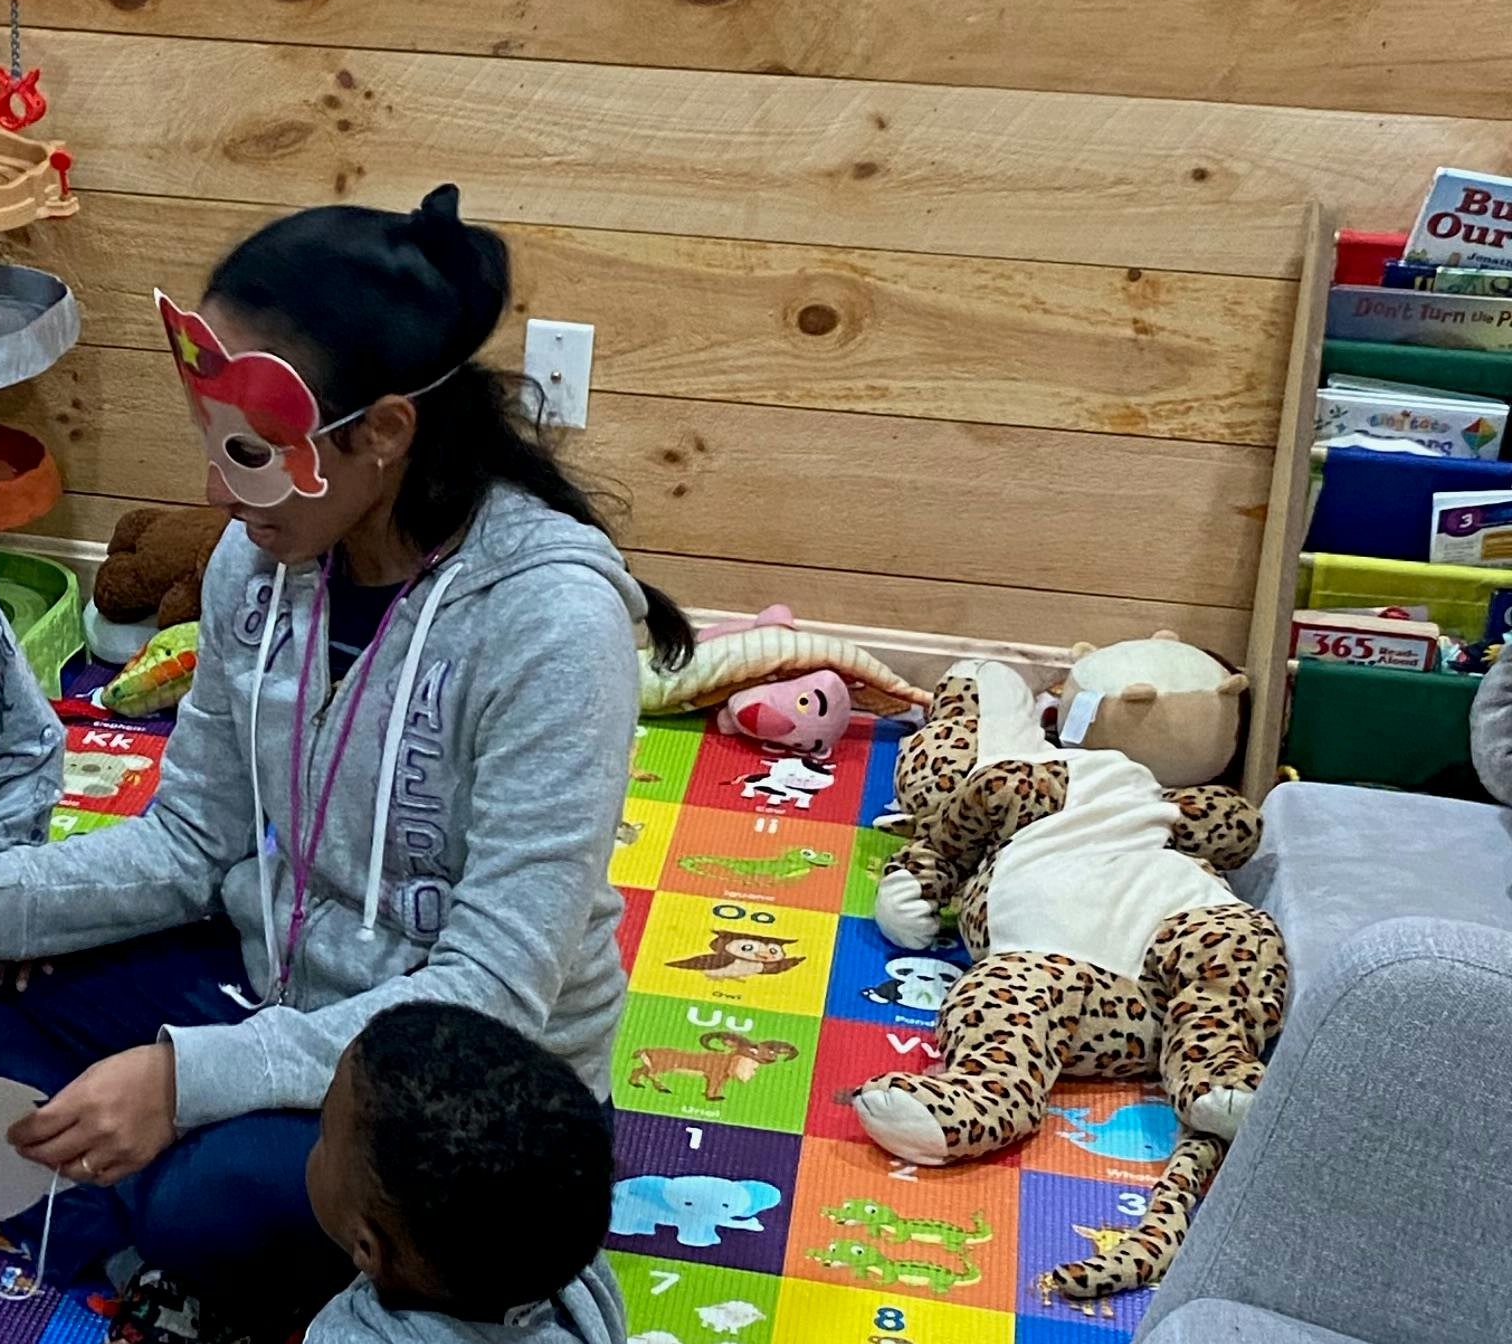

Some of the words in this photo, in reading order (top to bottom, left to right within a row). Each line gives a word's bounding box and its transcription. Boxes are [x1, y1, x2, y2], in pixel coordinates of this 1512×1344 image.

[1426, 211, 1512, 248] Our
[1352, 297, 1412, 320] Don't
[1419, 303, 1467, 324] Turn
[1470, 309, 1494, 324] the
[1459, 513, 1473, 528] 3
[1310, 633, 1375, 659] 365
[1376, 656, 1420, 667] Aloud
[81, 730, 135, 751] Kk
[390, 658, 455, 942] AERO
[712, 904, 776, 924] Oo
[711, 990, 743, 1001] Owl
[686, 1006, 754, 1032] Uu
[894, 1014, 936, 1027] Pand
[685, 1127, 703, 1150] 1
[1116, 1192, 1148, 1216] 3
[648, 1269, 681, 1295] 7
[873, 1306, 906, 1331] 8
